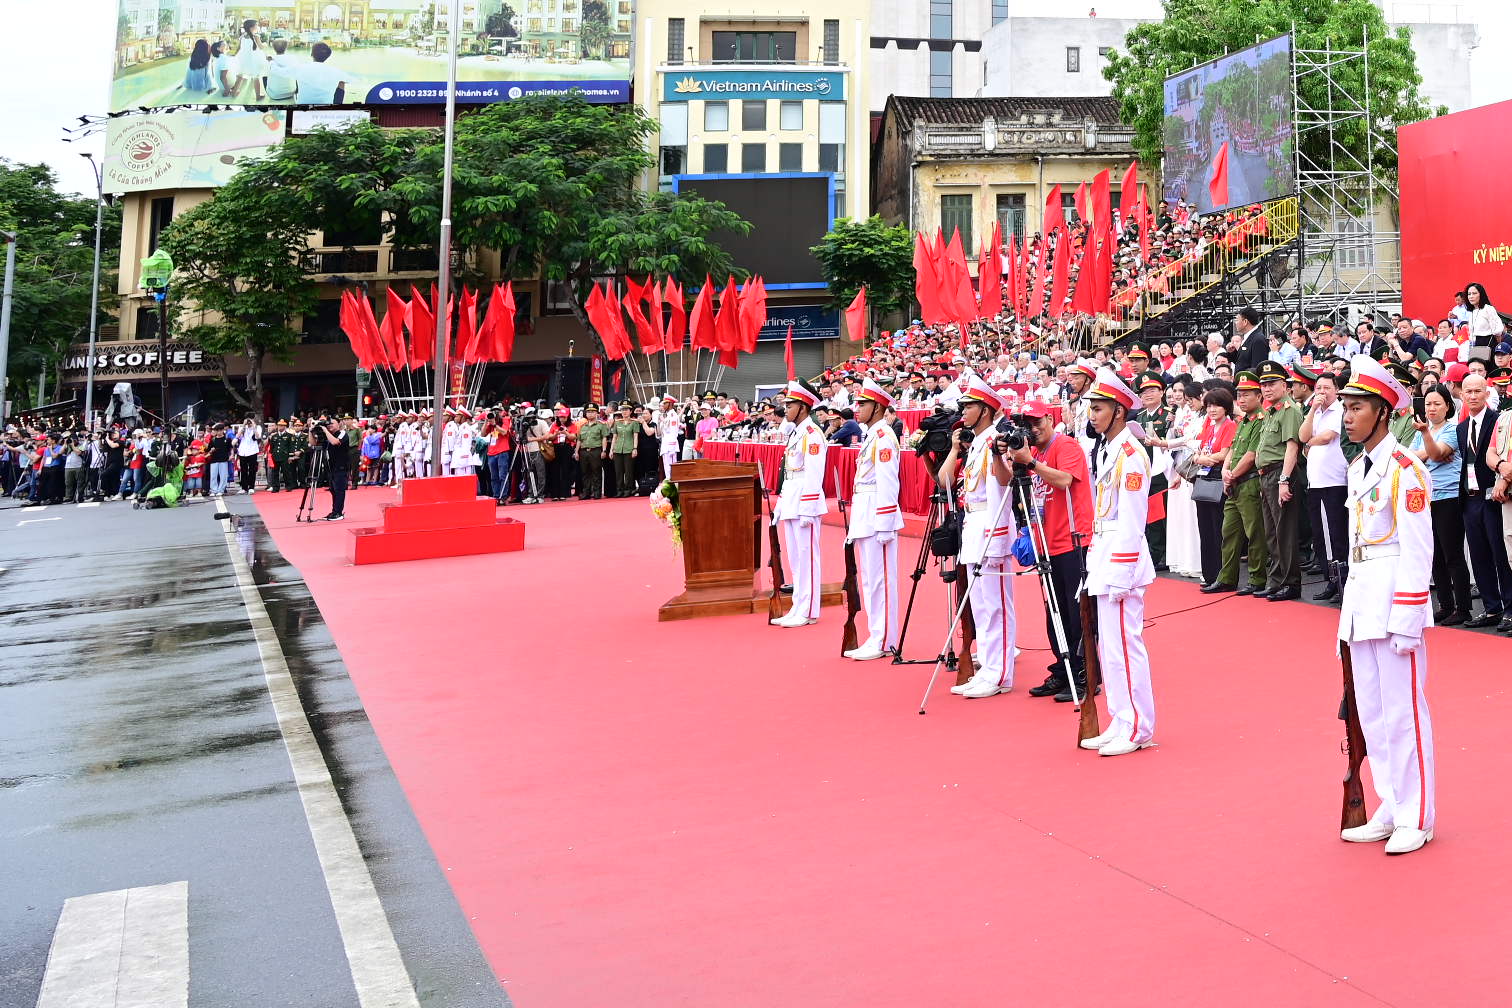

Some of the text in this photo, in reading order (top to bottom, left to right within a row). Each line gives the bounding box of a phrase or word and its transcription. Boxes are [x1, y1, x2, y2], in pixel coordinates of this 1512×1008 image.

[701, 79, 761, 93] Vietnam
[762, 78, 813, 93] Airlines
[396, 89, 416, 97] 1900
[417, 89, 437, 97] 2323
[1473, 244, 1488, 265] KỶ
[761, 316, 796, 327] irlines
